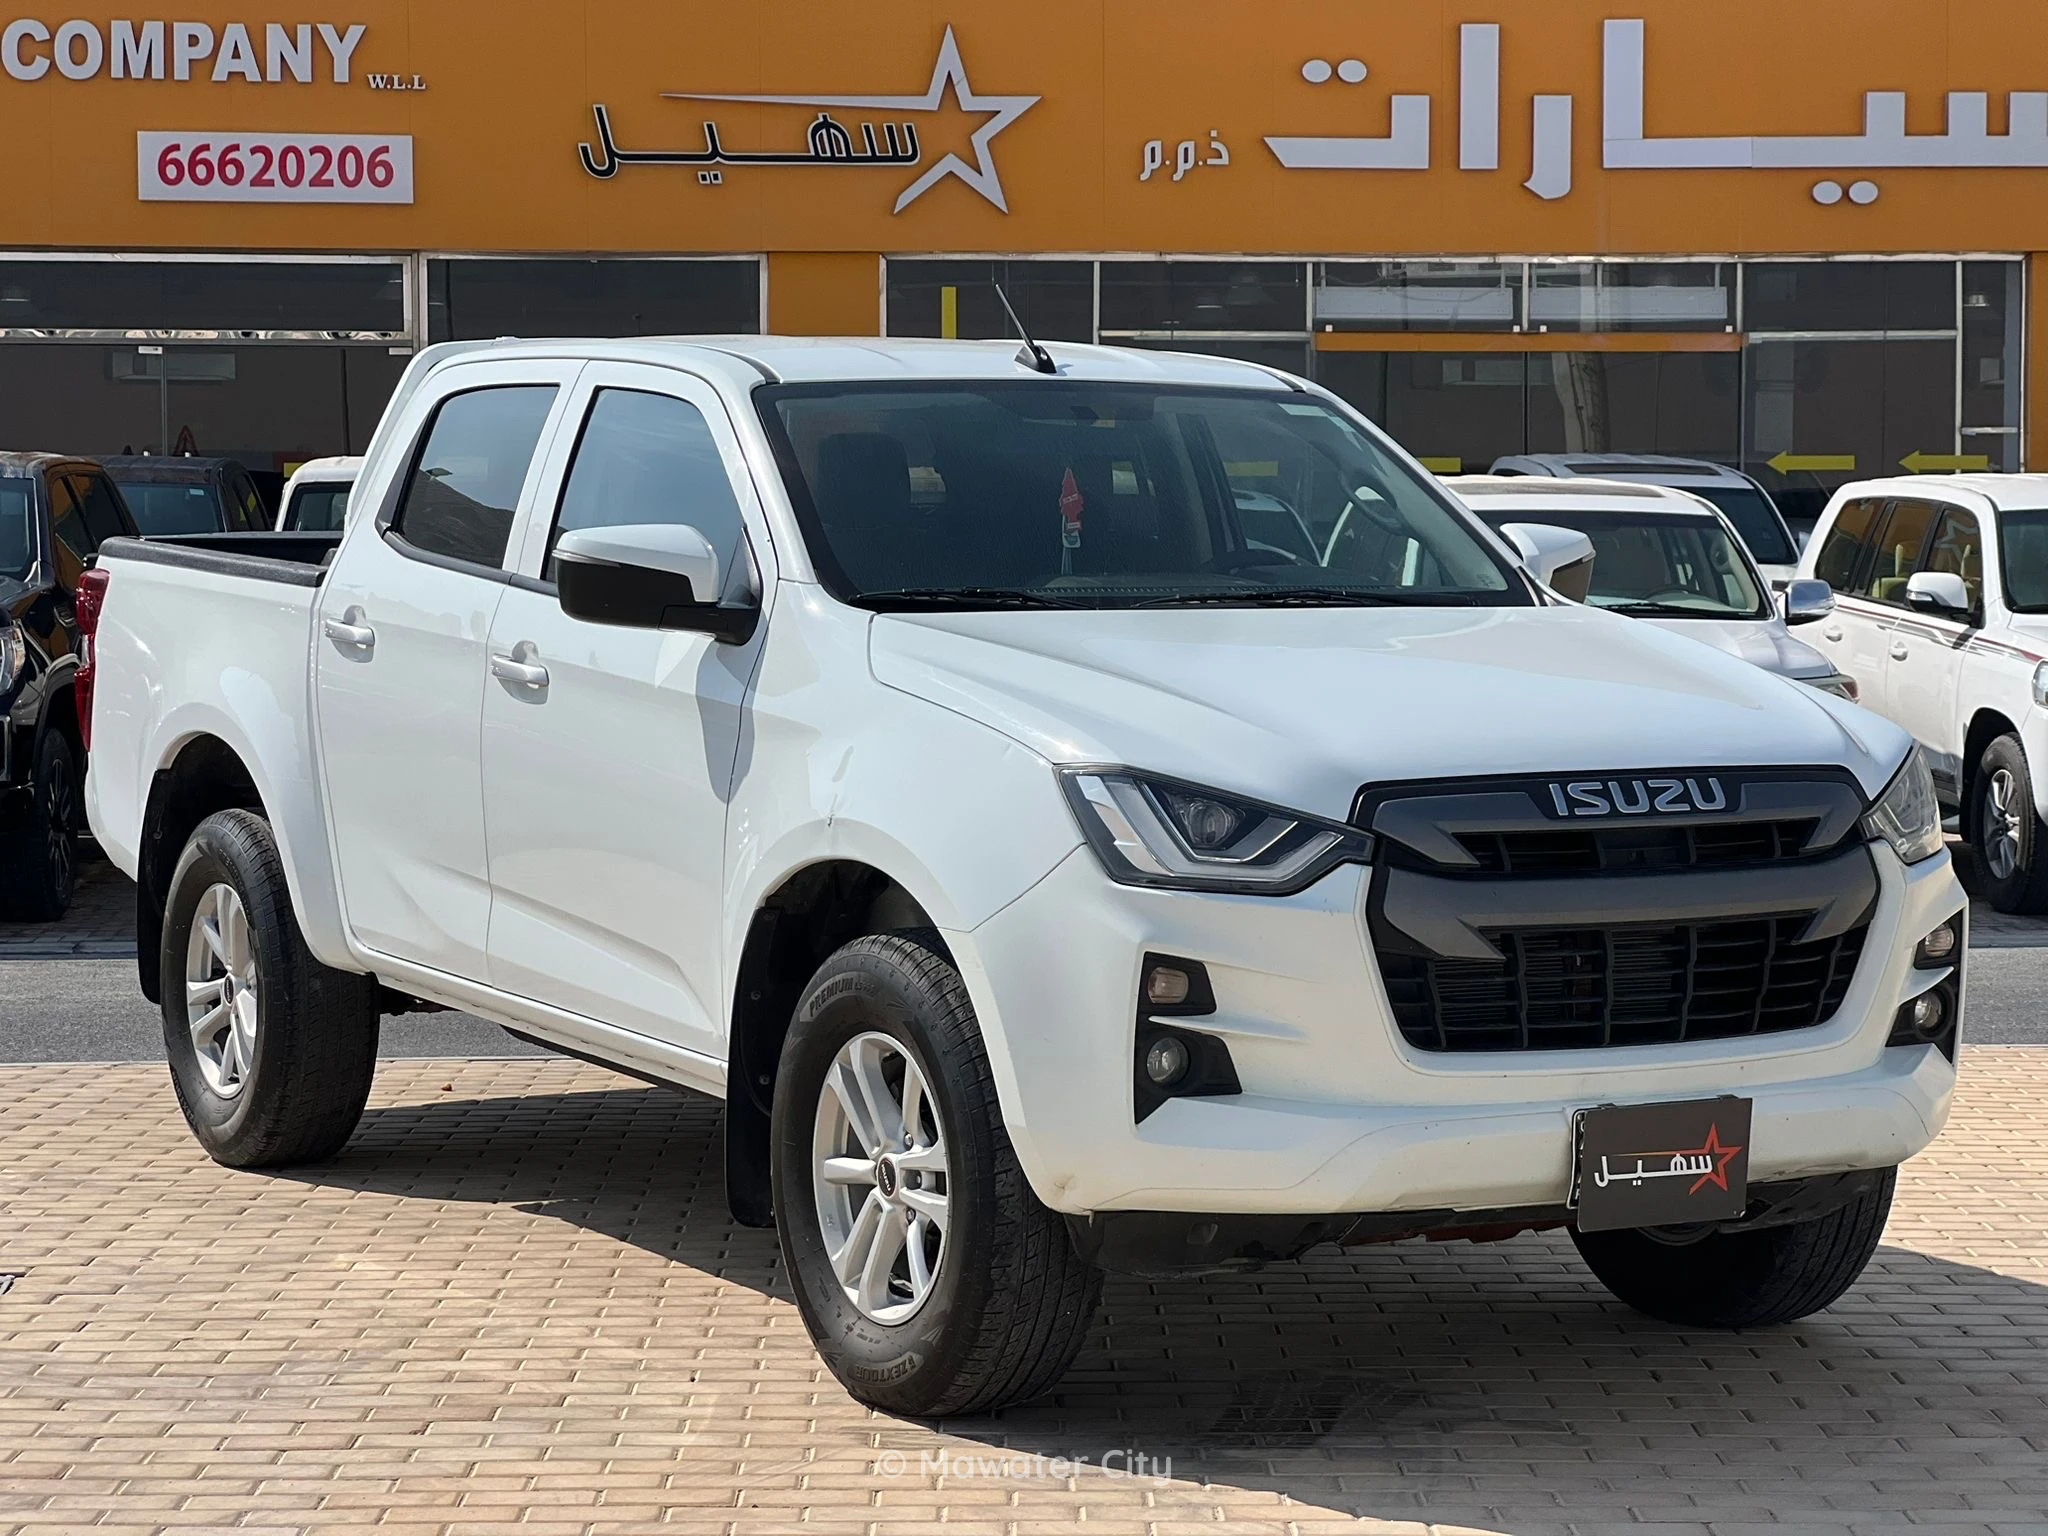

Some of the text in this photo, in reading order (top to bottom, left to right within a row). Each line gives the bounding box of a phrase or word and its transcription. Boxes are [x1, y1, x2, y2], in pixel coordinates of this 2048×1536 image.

[1, 19, 366, 83] COMPANY
[157, 143, 394, 188] 66620206
[578, 103, 920, 184] سهيل
[1548, 777, 1727, 816] ISUZU
[1593, 1153, 1713, 1188] سهيل
